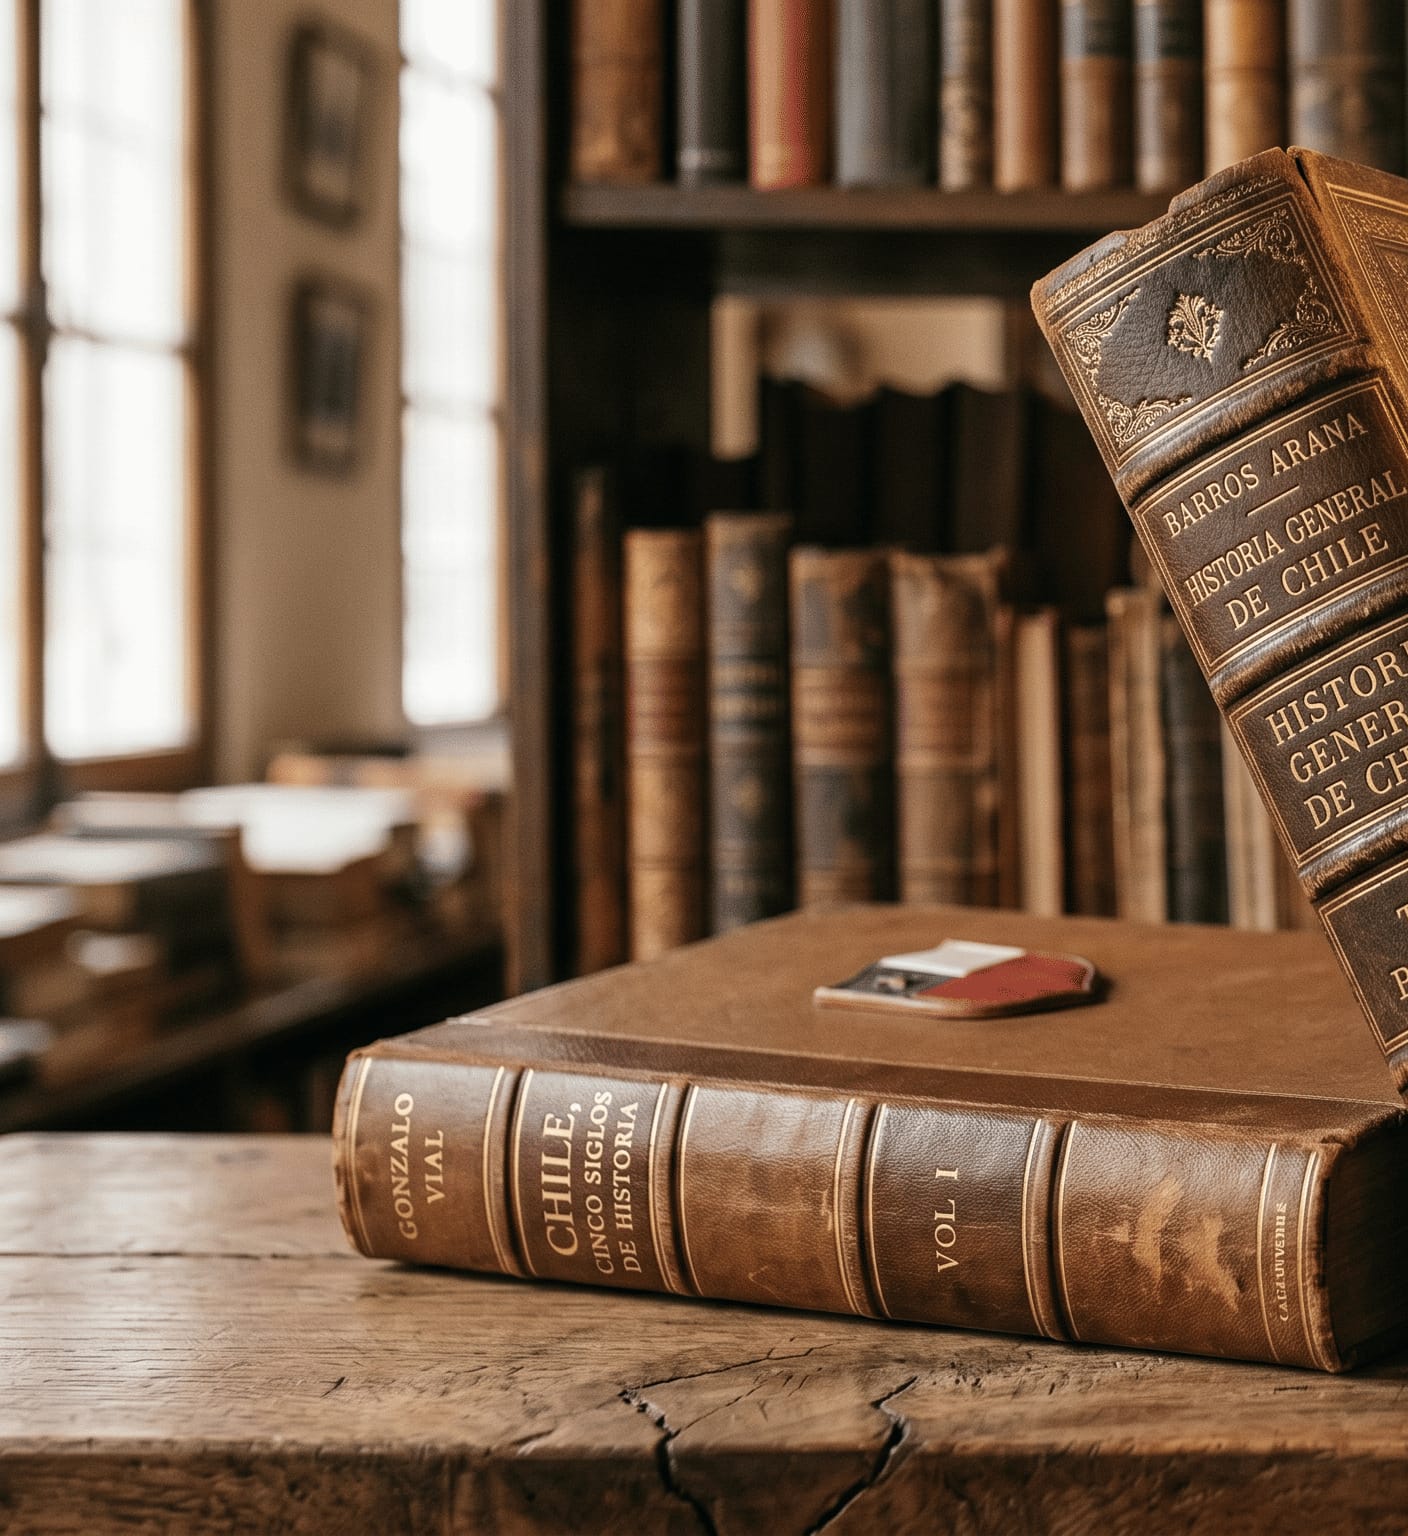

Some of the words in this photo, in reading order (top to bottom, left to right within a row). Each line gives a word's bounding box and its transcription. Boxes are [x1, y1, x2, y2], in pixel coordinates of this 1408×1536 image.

[1162, 464, 1260, 538] BARROS
[1271, 413, 1368, 476] ARANA
[1184, 530, 1285, 606] HISTORIA
[1285, 470, 1408, 545] GENERAL
[1224, 584, 1270, 631] DE
[1281, 522, 1389, 596] CHILE
[1303, 780, 1355, 830] DE
[390, 1092, 418, 1240] GONZALO
[424, 1130, 446, 1203] VIAL
[541, 1102, 582, 1256] CHILE,
[584, 1090, 613, 1190] SIGLOS
[613, 1102, 639, 1231] HISTORIA
[935, 1167, 959, 1180] I
[585, 1194, 614, 1274] CINCO
[614, 1240, 642, 1273] DE
[934, 1199, 960, 1272] VOL
